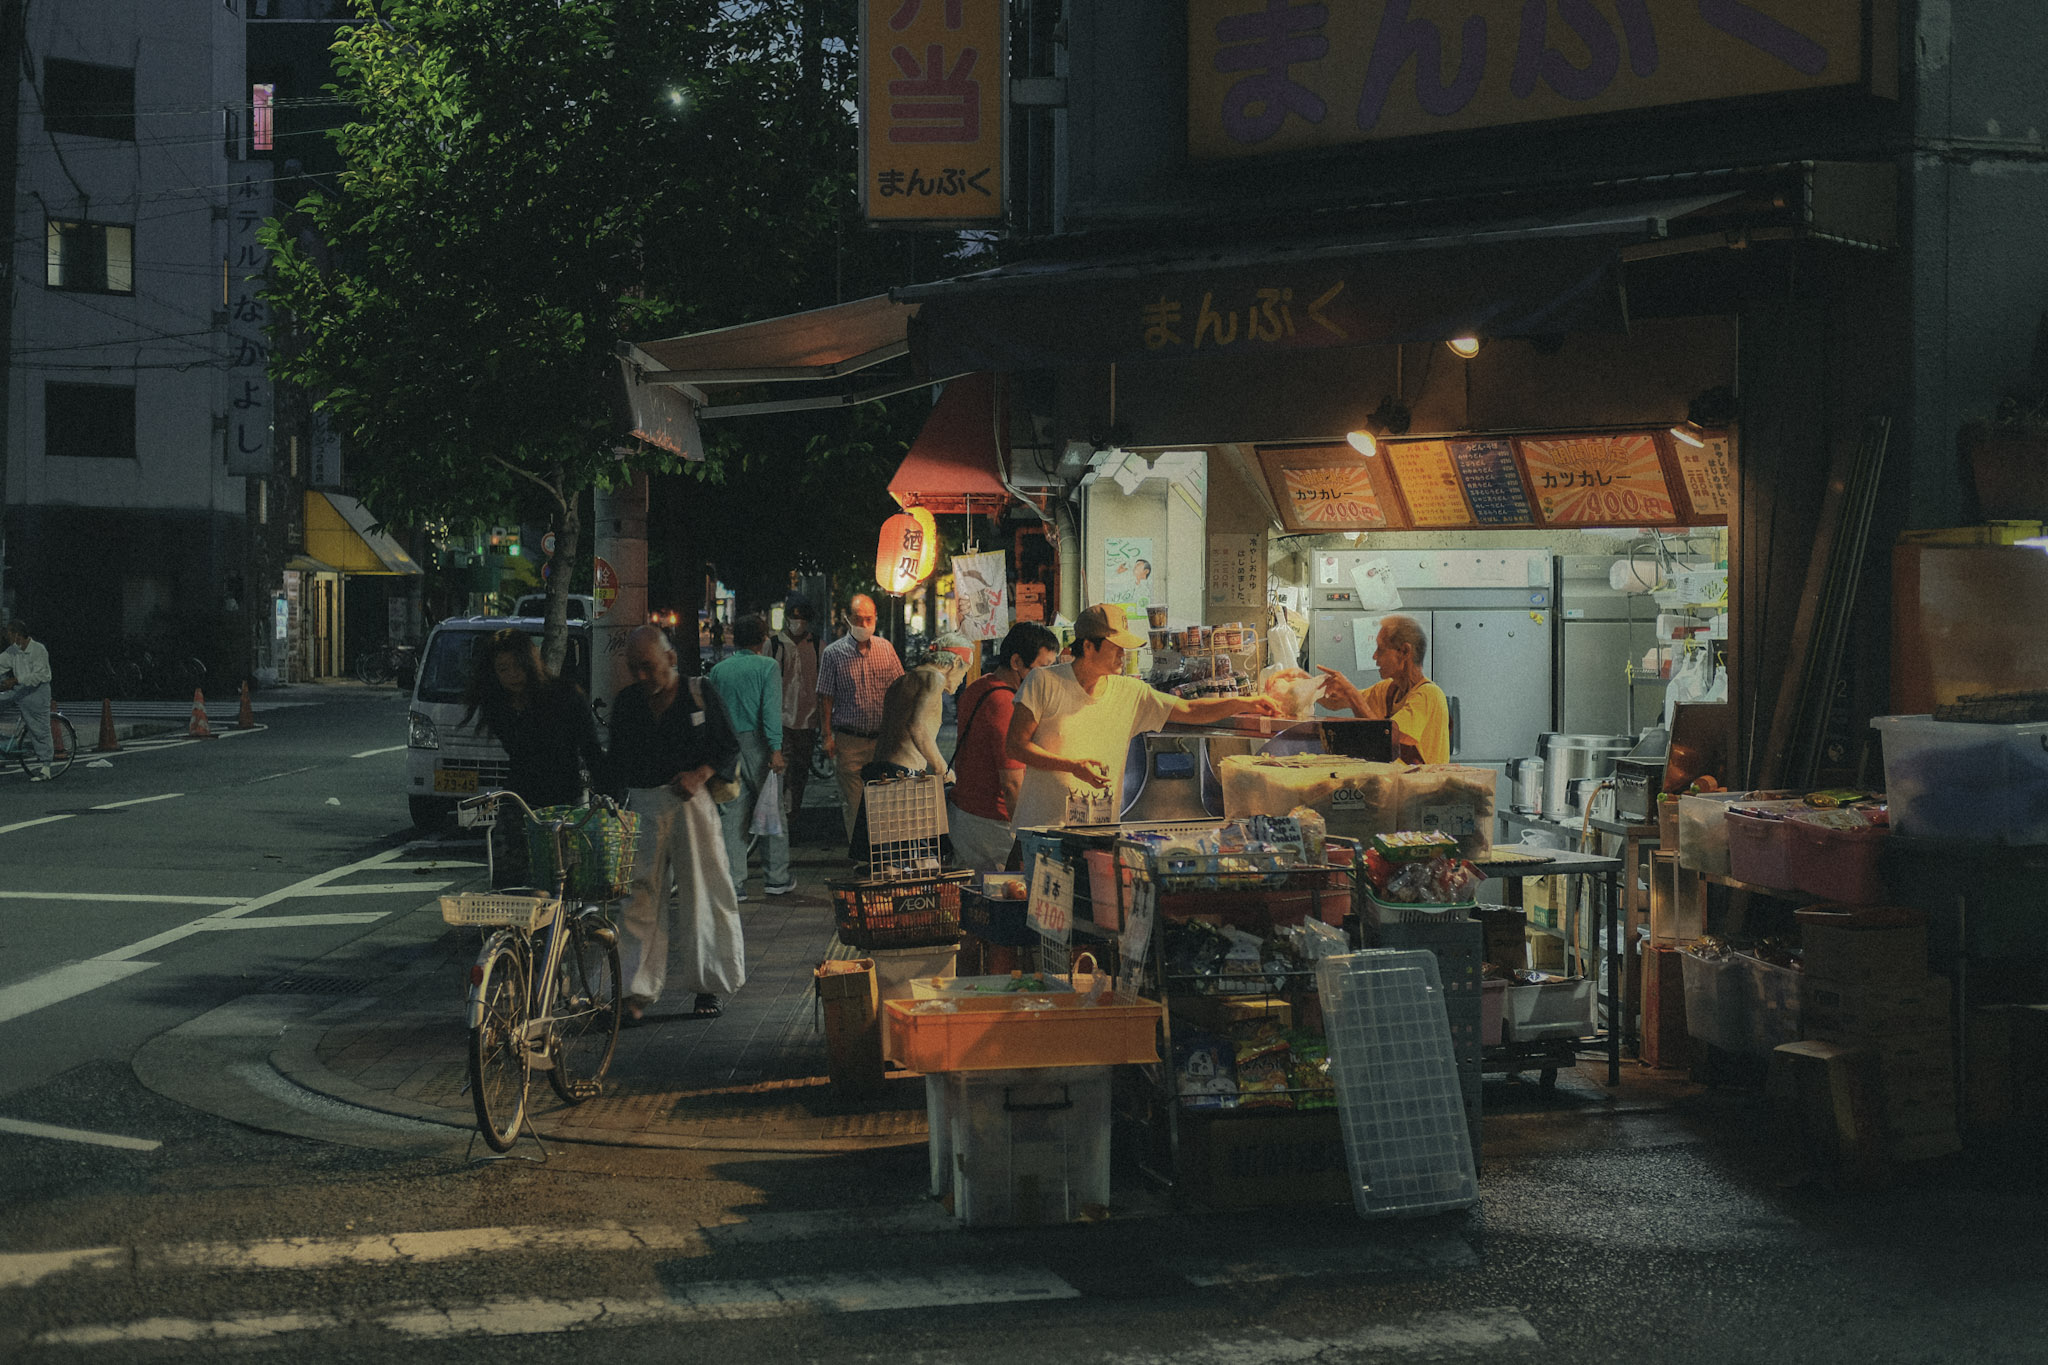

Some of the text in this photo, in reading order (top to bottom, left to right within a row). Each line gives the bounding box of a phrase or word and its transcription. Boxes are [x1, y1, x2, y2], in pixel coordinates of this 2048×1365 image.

[878, 168, 992, 197] まんぷく
[1143, 280, 1349, 349] まんぷく
[1550, 444, 1629, 466] 期間限定
[1541, 470, 1632, 489] カツカレー
[1296, 488, 1353, 500] カツカレー
[1586, 489, 1662, 516] 400円
[1325, 501, 1374, 518] 400円
[899, 528, 923, 580] 酒処
[1249, 538, 1257, 590] 冷やしおかゆ
[1271, 833, 1300, 843] Cookies
[1034, 897, 1065, 933] ¥100
